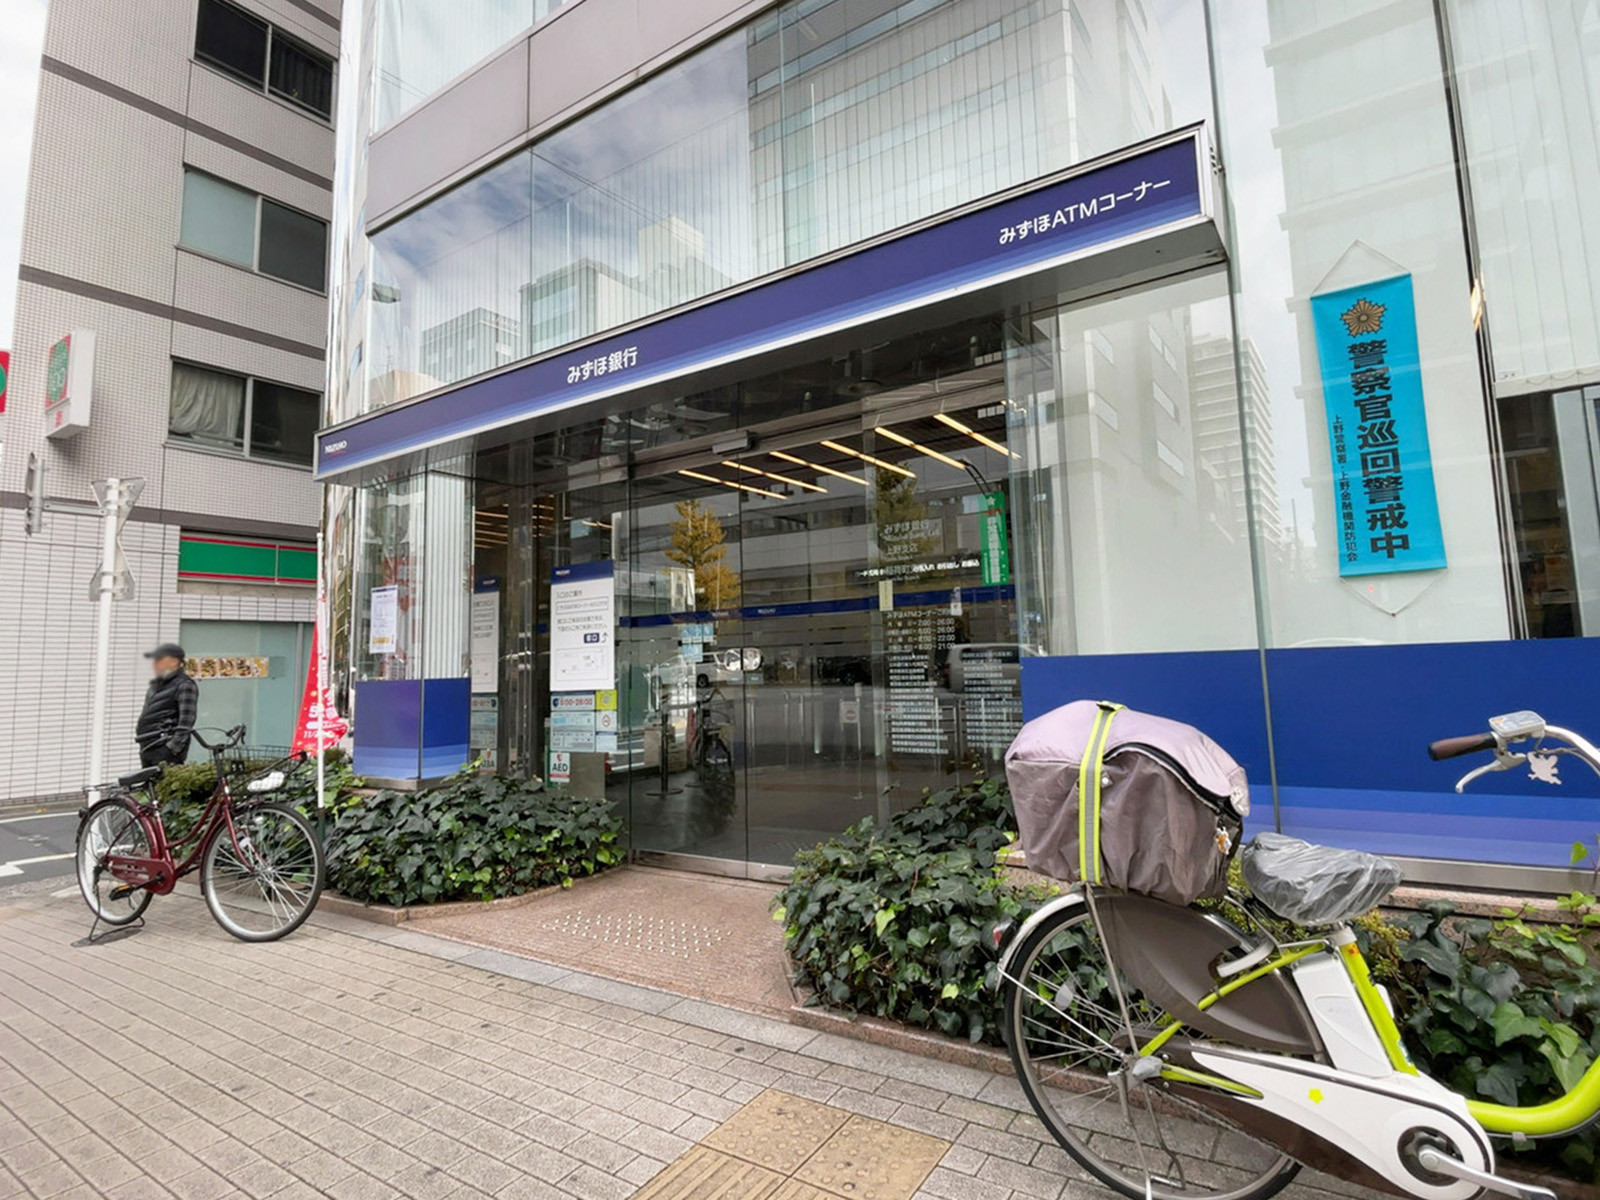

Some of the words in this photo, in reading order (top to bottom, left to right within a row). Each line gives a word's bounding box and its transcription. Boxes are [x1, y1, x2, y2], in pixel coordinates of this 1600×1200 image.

[999, 179, 1171, 244] みずほATMコーナー
[566, 346, 638, 384] みずほ銀行
[1347, 339, 1410, 559] 警察官巡回警戒中
[552, 762, 568, 773] AED
